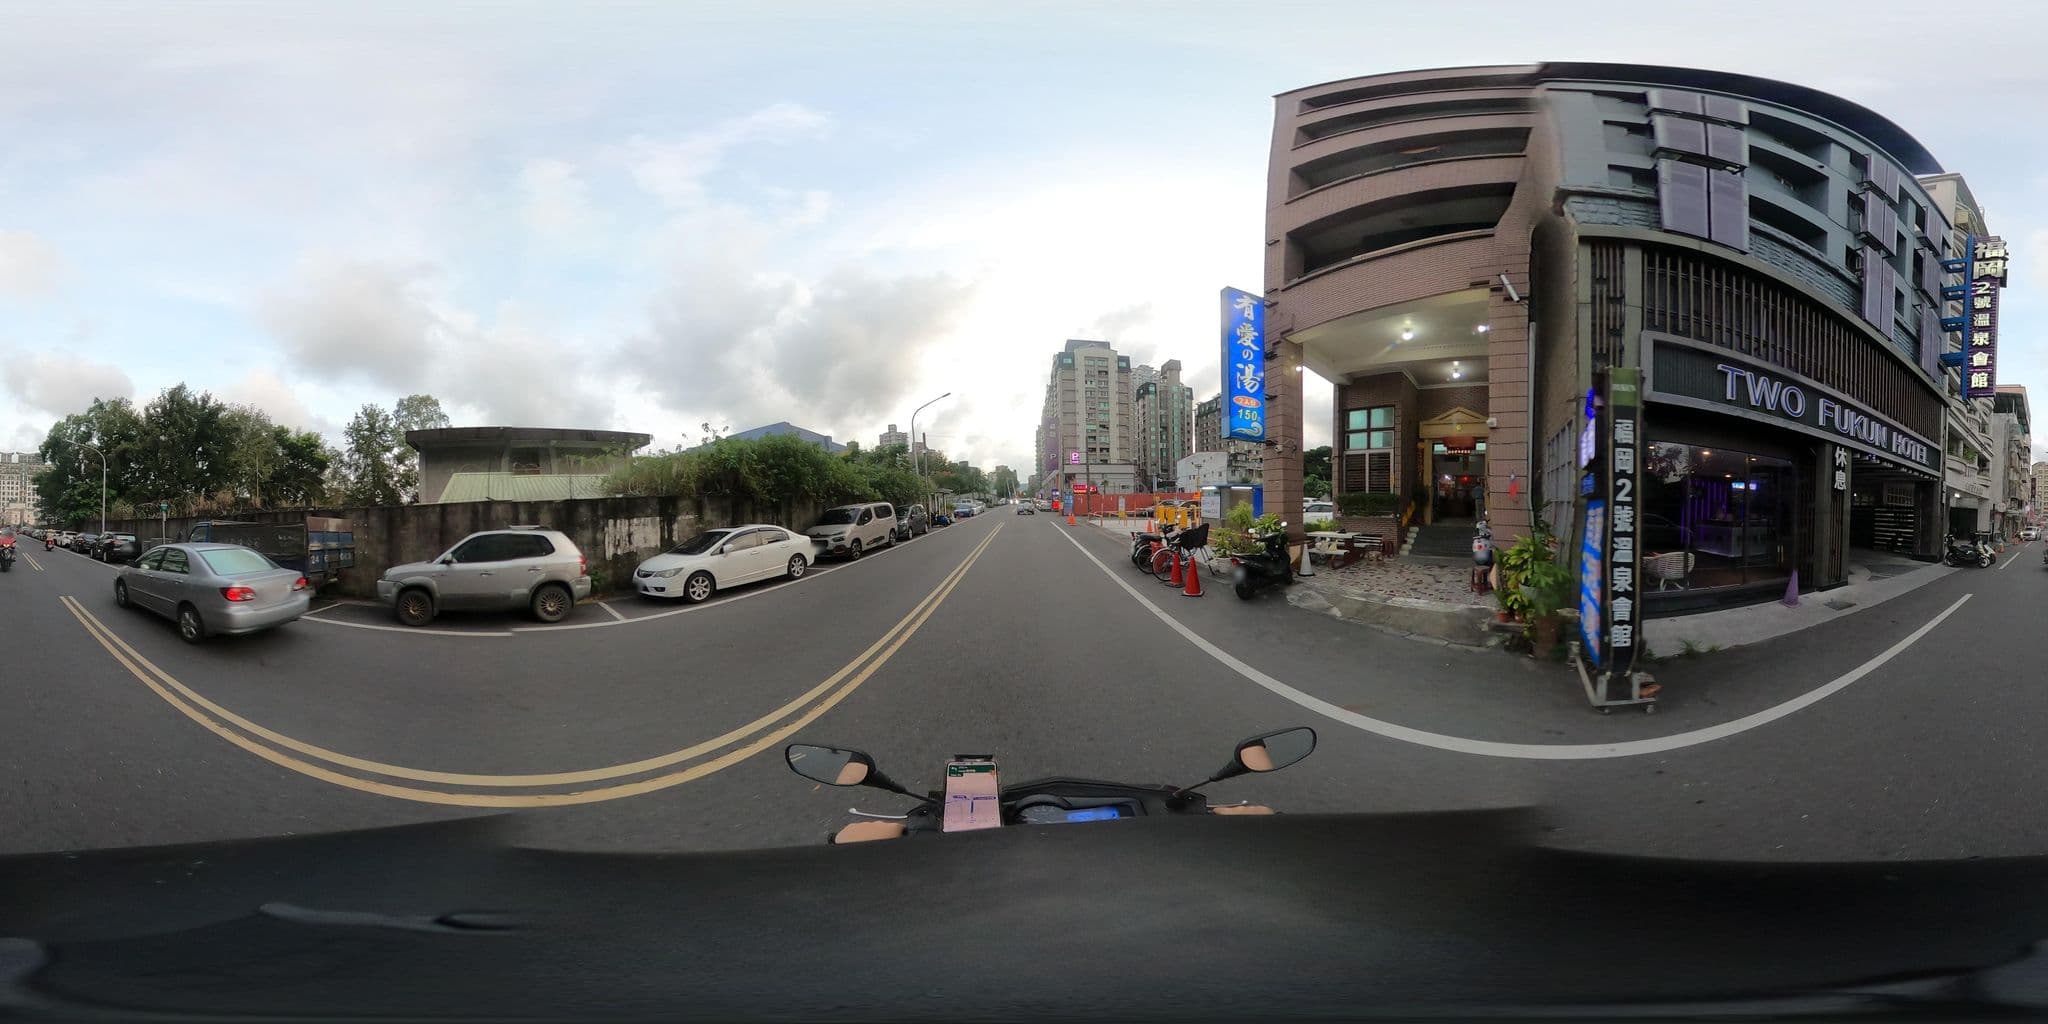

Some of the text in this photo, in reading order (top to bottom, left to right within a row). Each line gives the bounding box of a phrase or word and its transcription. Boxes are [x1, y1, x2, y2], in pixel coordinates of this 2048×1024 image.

[1233, 295, 1261, 394] 有愛の湯
[1971, 241, 2008, 388] 福岡2號溫泉會館
[1716, 363, 1929, 465] TWO FUKUN HOTEL
[1834, 446, 1847, 490] 休息
